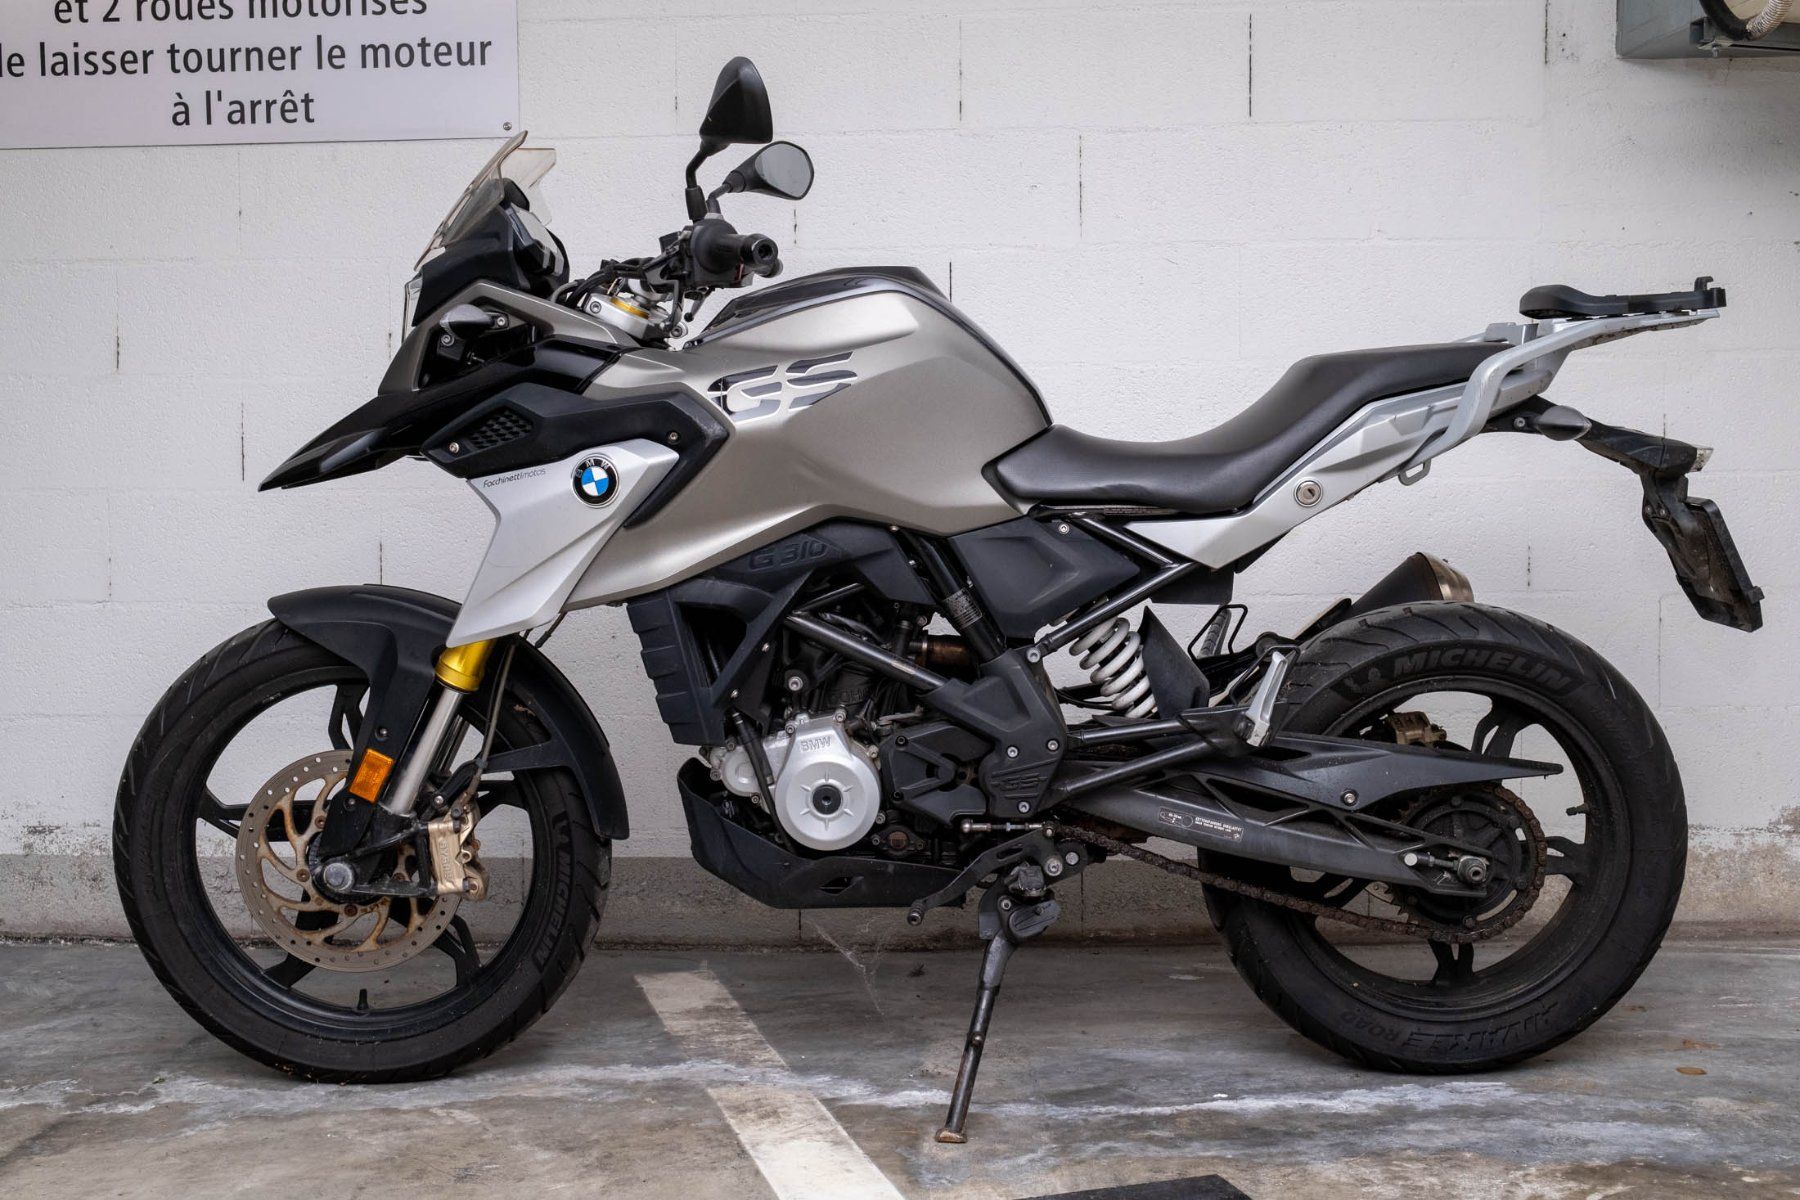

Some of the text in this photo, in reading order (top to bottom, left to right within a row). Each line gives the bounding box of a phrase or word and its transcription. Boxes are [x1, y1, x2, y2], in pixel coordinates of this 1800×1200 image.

[54, 0, 89, 23] et
[103, 0, 120, 22] 2
[137, 0, 234, 21] roues
[0, 35, 492, 77] e laisser tourner le moteur
[172, 90, 315, 126] à l'arrêt
[706, 351, 859, 425] GS
[575, 458, 610, 479] BMW
[749, 539, 828, 572] G 310
[1394, 648, 1575, 692] MICHELIN
[801, 736, 831, 752] BMW
[533, 851, 572, 964] MICHELIN
